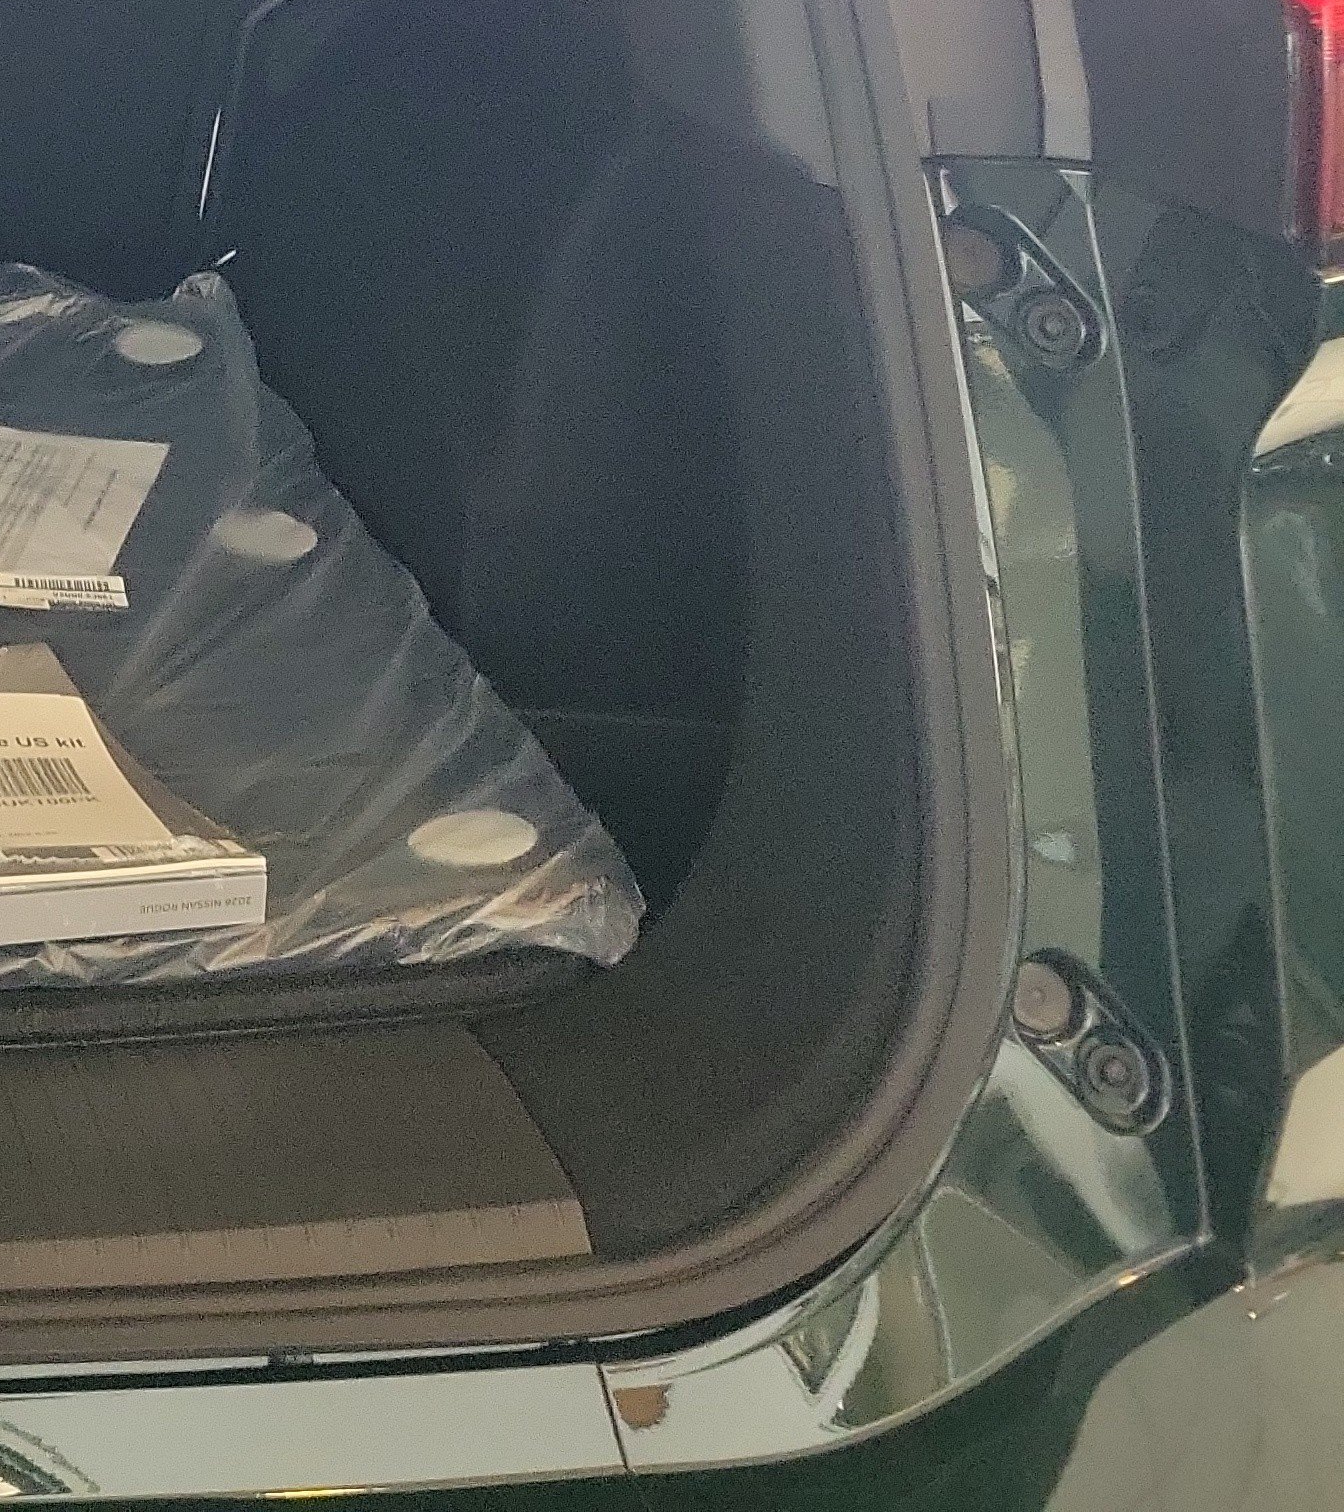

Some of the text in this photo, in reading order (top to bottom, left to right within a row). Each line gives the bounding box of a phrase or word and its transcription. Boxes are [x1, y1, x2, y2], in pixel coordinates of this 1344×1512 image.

[15, 736, 49, 747] US
[55, 737, 86, 748] kit
[139, 903, 179, 915] ROGUE
[181, 899, 222, 911] NISSAN
